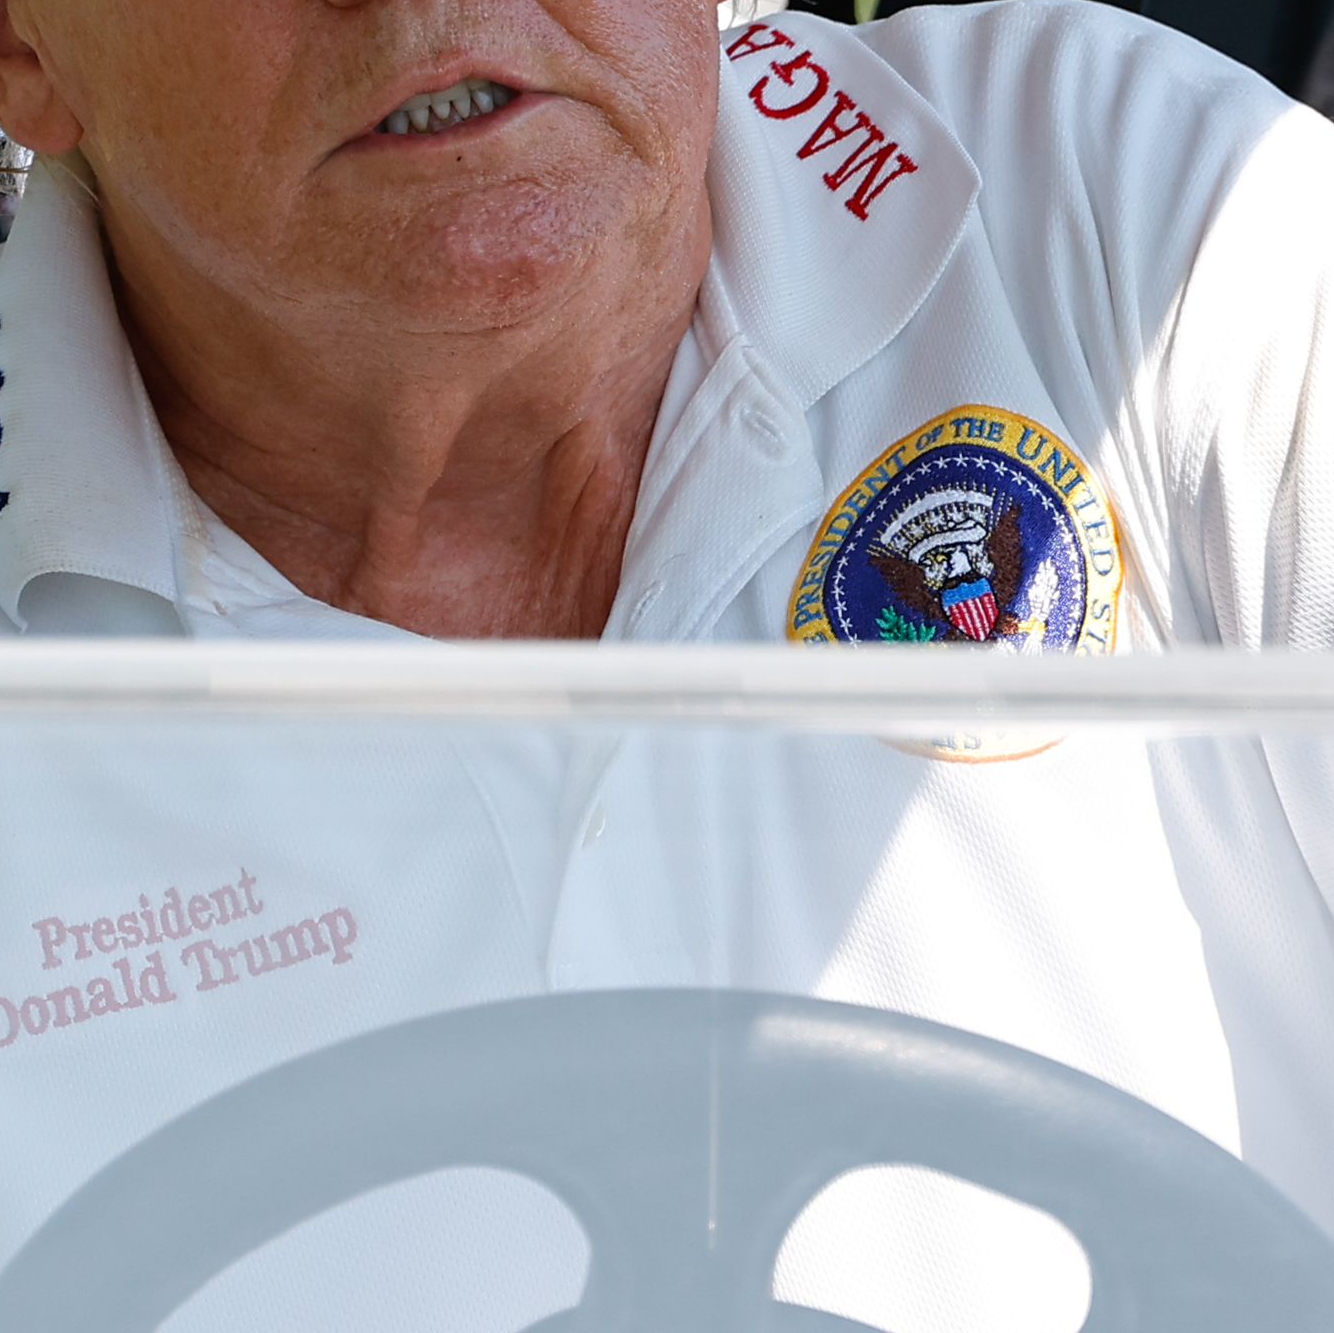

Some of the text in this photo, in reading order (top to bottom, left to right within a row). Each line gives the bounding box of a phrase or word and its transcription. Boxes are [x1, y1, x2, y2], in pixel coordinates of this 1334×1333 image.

[725, 23, 918, 222] MAGA
[793, 444, 908, 630] PRESIDENT
[916, 423, 945, 452] OF
[950, 416, 1005, 443] THE
[1017, 425, 1115, 578] UNITED
[32, 866, 264, 970] President
[180, 907, 359, 992] Trump
